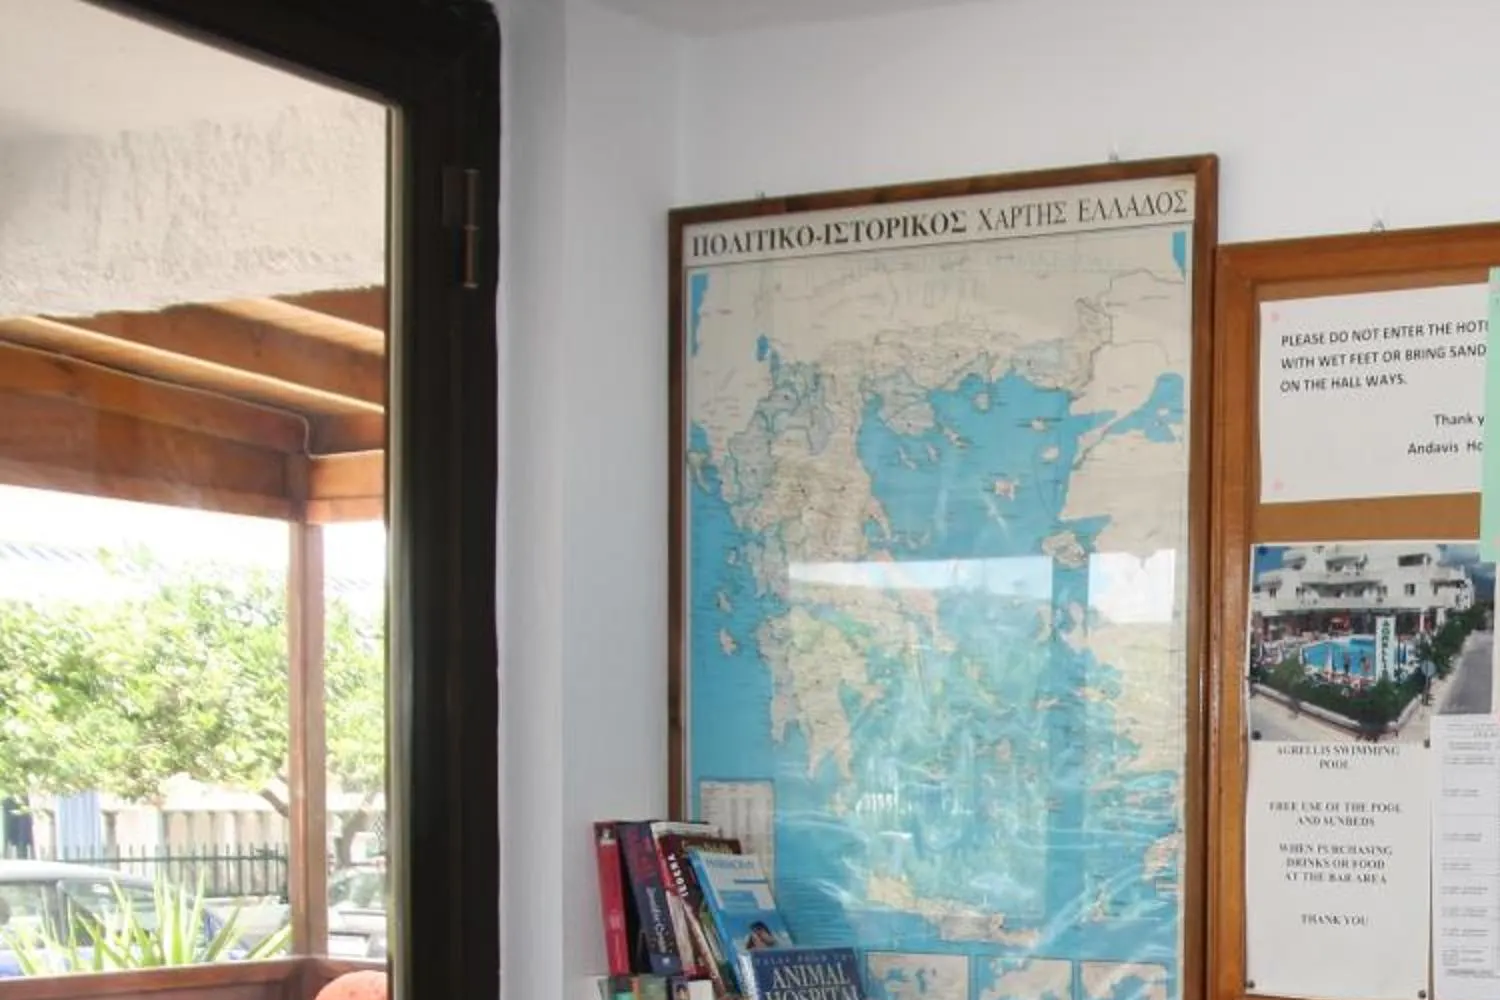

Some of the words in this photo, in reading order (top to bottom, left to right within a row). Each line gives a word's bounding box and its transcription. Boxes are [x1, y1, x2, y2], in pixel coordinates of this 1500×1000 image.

[976, 200, 1067, 232] ΧΑΡΤΗΣ
[1076, 188, 1189, 223] ΕΛΛΑΔΟΣ
[1281, 332, 1325, 347] PLEASE
[1329, 331, 1349, 344] DO
[1352, 328, 1379, 342] NOT
[1383, 324, 1423, 338] ENTER
[1428, 322, 1452, 336] THE
[1281, 355, 1315, 369] WITH
[1318, 353, 1347, 367] WET
[1350, 351, 1379, 365] FEET
[1382, 349, 1401, 363] OR
[1405, 346, 1446, 361] BRING
[1450, 344, 1488, 358] SAND
[1280, 379, 1300, 393] ON
[1303, 377, 1327, 391] THE
[1331, 375, 1361, 389] HALL
[1365, 373, 1407, 387] WAYS.
[1434, 413, 1473, 427] Thank
[1407, 441, 1459, 454] Andavis
[1319, 759, 1350, 770] POOL
[1269, 802, 1297, 812] FREE
[1301, 802, 1322, 812] USE
[1345, 803, 1367, 813] THE
[1298, 816, 1321, 826] AND
[1323, 817, 1375, 827] SUNBEDS
[1280, 843, 1313, 854] WHEN
[1286, 858, 1330, 868] DRINKS
[1333, 859, 1349, 869] OR
[1352, 859, 1385, 869] FOOD
[1285, 872, 1298, 882] AT
[1303, 872, 1323, 882] THE
[1328, 873, 1352, 883] BAR
[1357, 874, 1387, 884] AREA
[1301, 914, 1341, 925] THANK
[1344, 915, 1368, 926] YOU
[772, 963, 850, 989] ANIMAL
